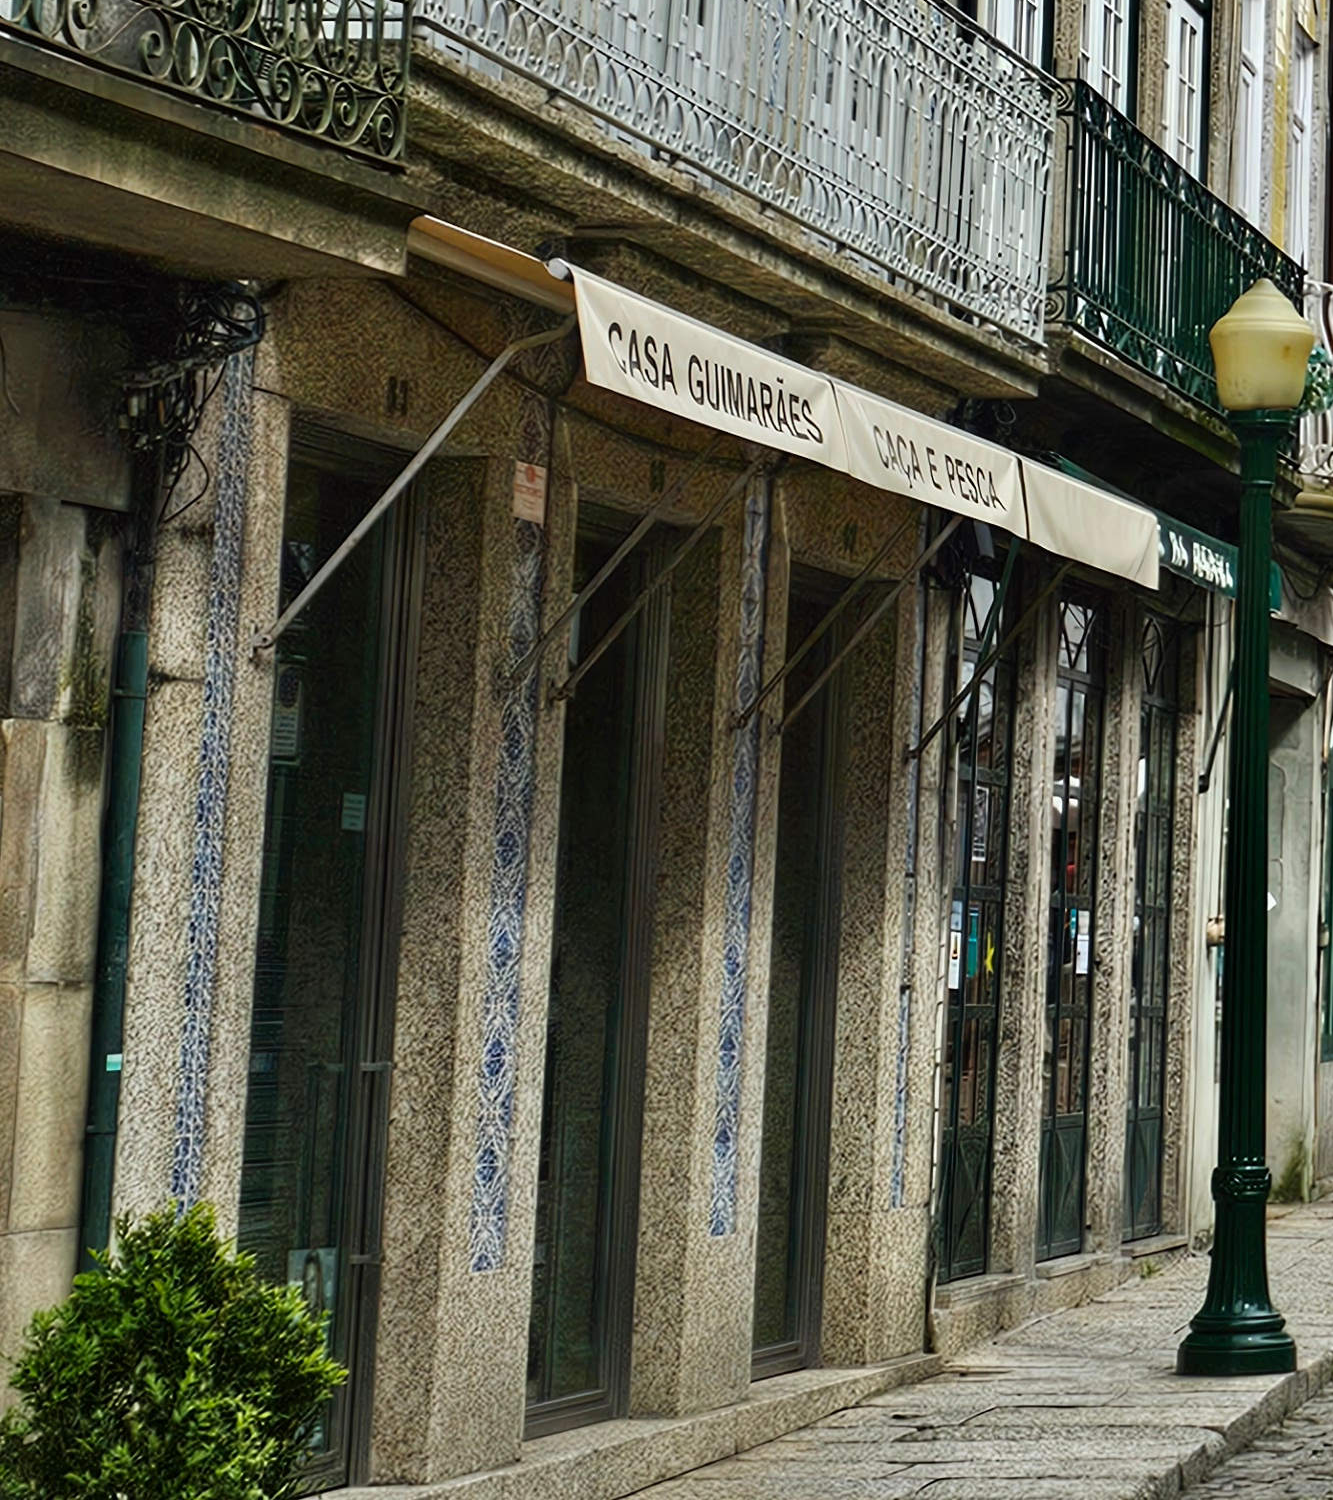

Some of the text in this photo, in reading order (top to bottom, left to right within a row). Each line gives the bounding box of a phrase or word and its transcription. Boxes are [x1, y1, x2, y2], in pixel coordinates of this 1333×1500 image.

[608, 322, 824, 444] CASA GUIMARÃES
[873, 425, 1007, 511] CAÇA E PESCA
